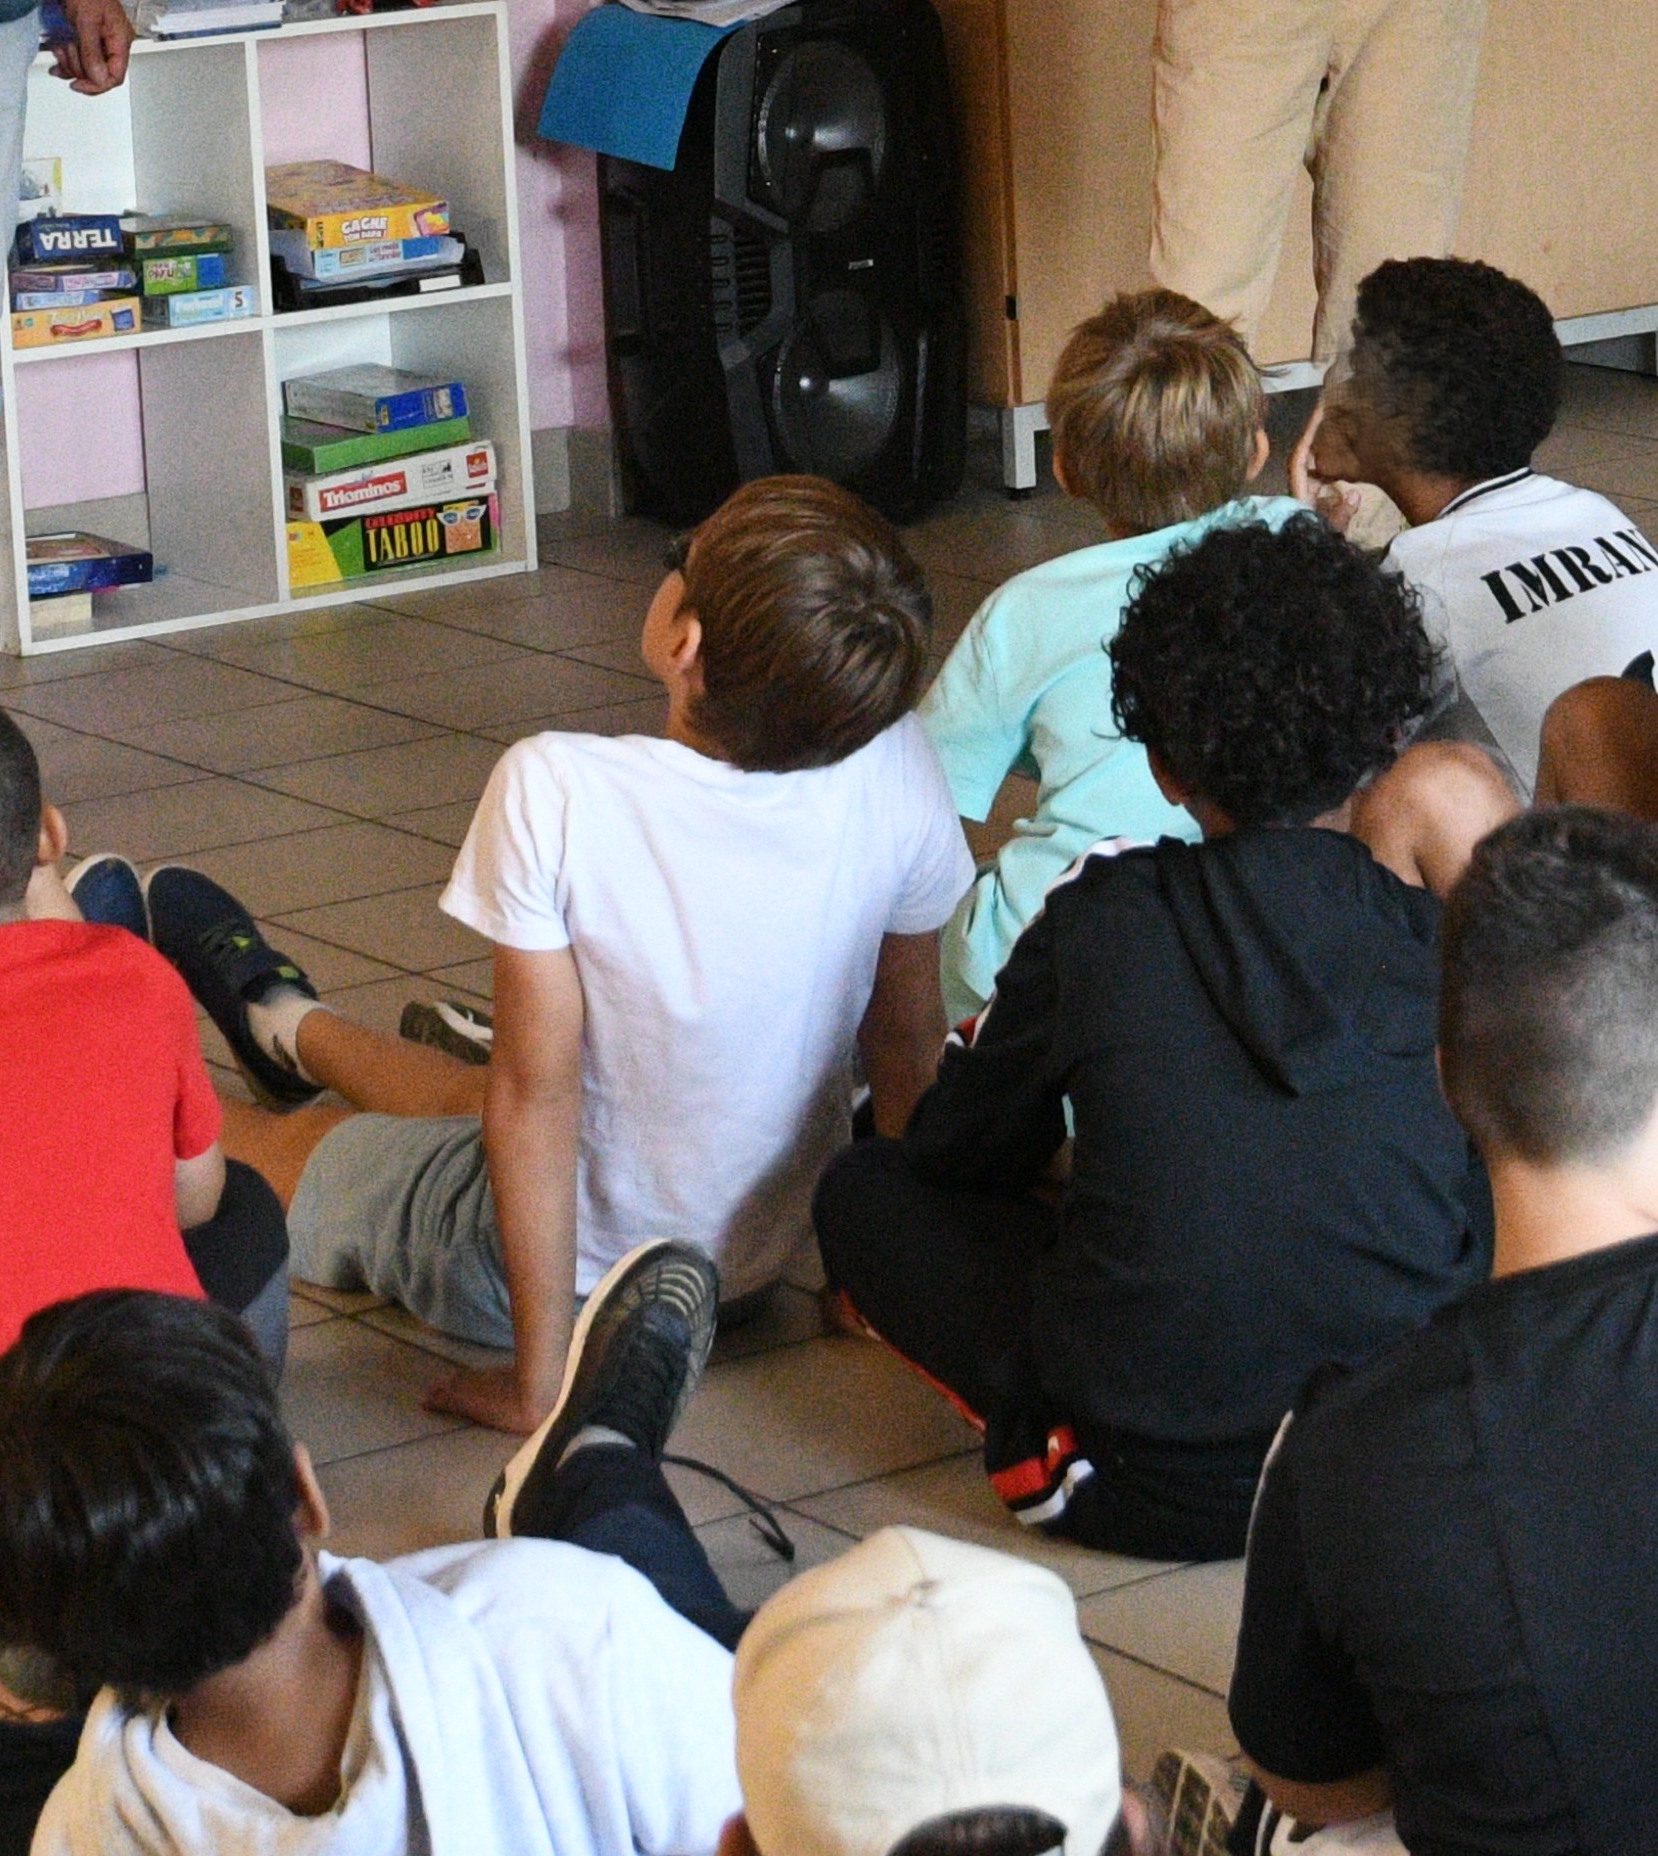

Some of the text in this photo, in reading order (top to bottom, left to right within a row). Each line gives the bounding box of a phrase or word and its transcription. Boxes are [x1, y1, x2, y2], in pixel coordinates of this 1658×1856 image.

[342, 215, 390, 234] GAGNE
[39, 229, 117, 251] TERRA
[366, 518, 439, 563] TABOO
